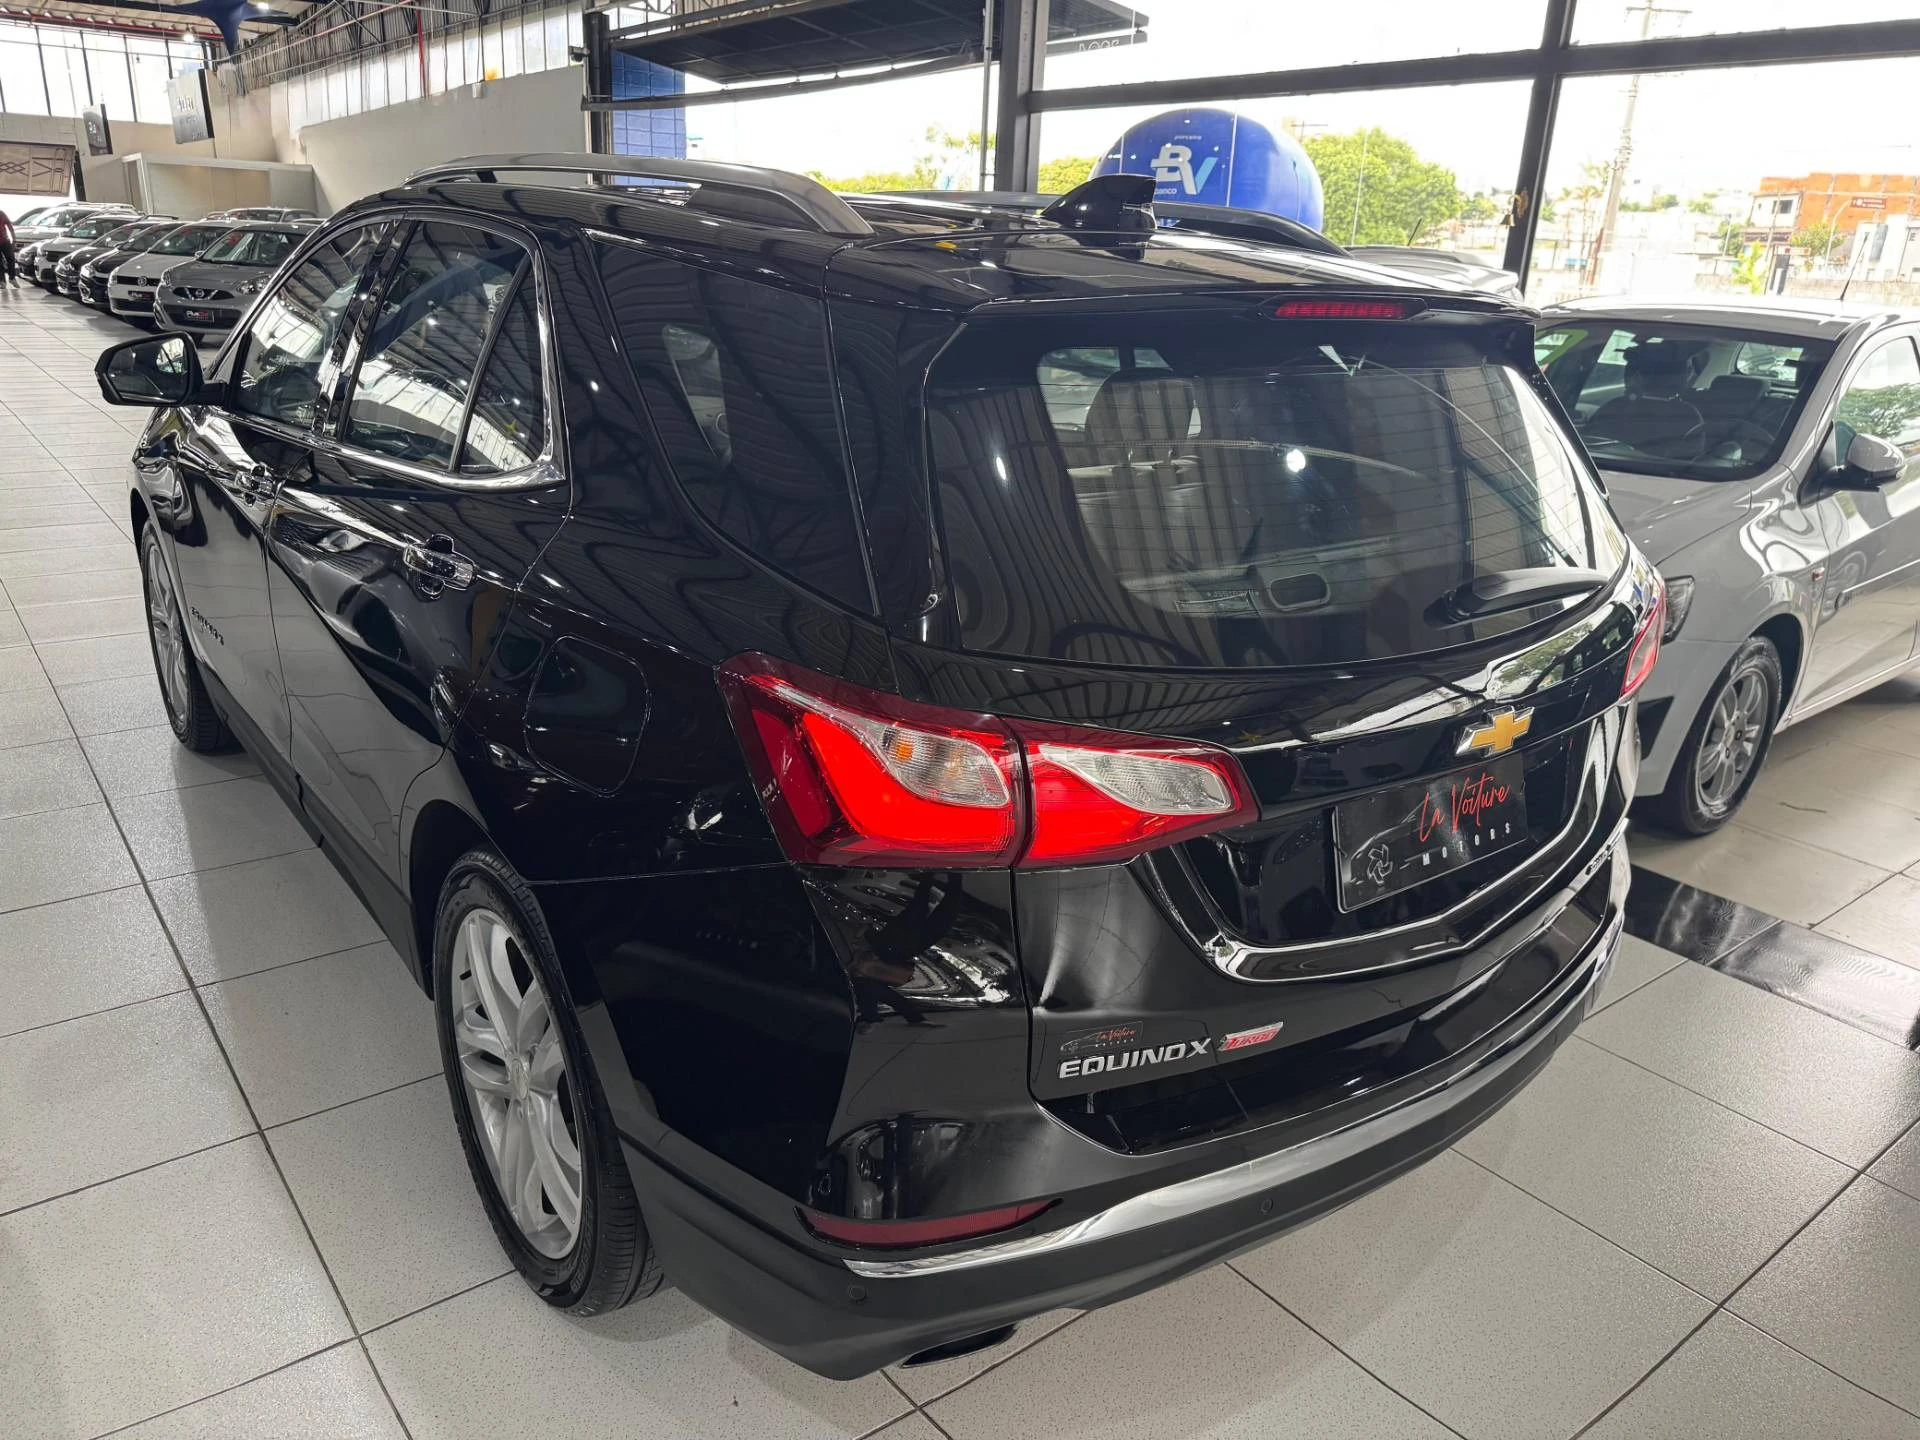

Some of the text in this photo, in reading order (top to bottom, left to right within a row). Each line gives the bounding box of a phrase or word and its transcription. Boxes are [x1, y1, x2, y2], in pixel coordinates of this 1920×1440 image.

[1150, 144, 1219, 195] BV
[1419, 772, 1512, 842] La Voiture
[1422, 822, 1511, 866] MOTORS
[1058, 1037, 1212, 1080] EQUINOX
